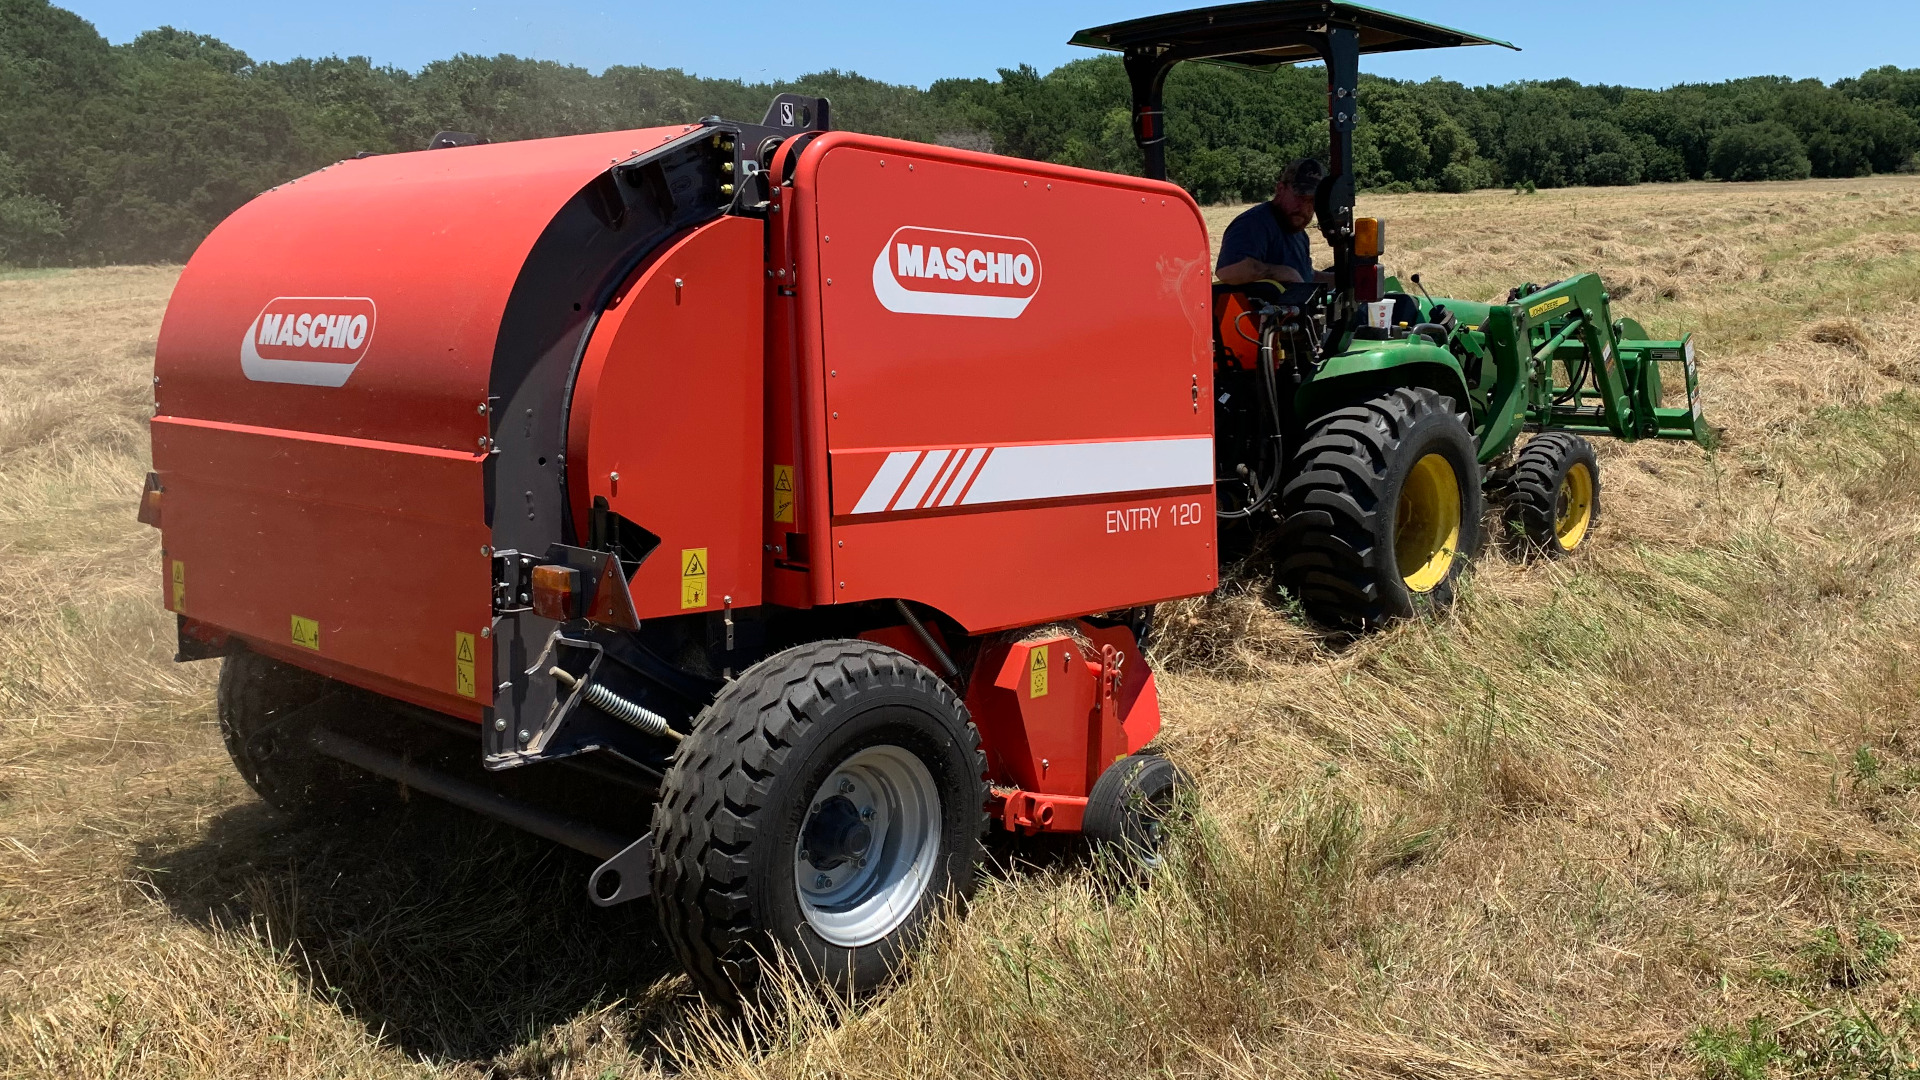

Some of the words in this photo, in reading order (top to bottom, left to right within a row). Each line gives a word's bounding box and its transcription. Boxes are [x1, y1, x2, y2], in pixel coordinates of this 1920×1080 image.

[897, 243, 1034, 286] MASCHIO
[1532, 306, 1544, 316] JOHN
[1544, 300, 1559, 311] DEERE
[258, 313, 368, 350] MASCHIO
[1106, 506, 1162, 534] ENTRY
[1170, 502, 1202, 527] 120
